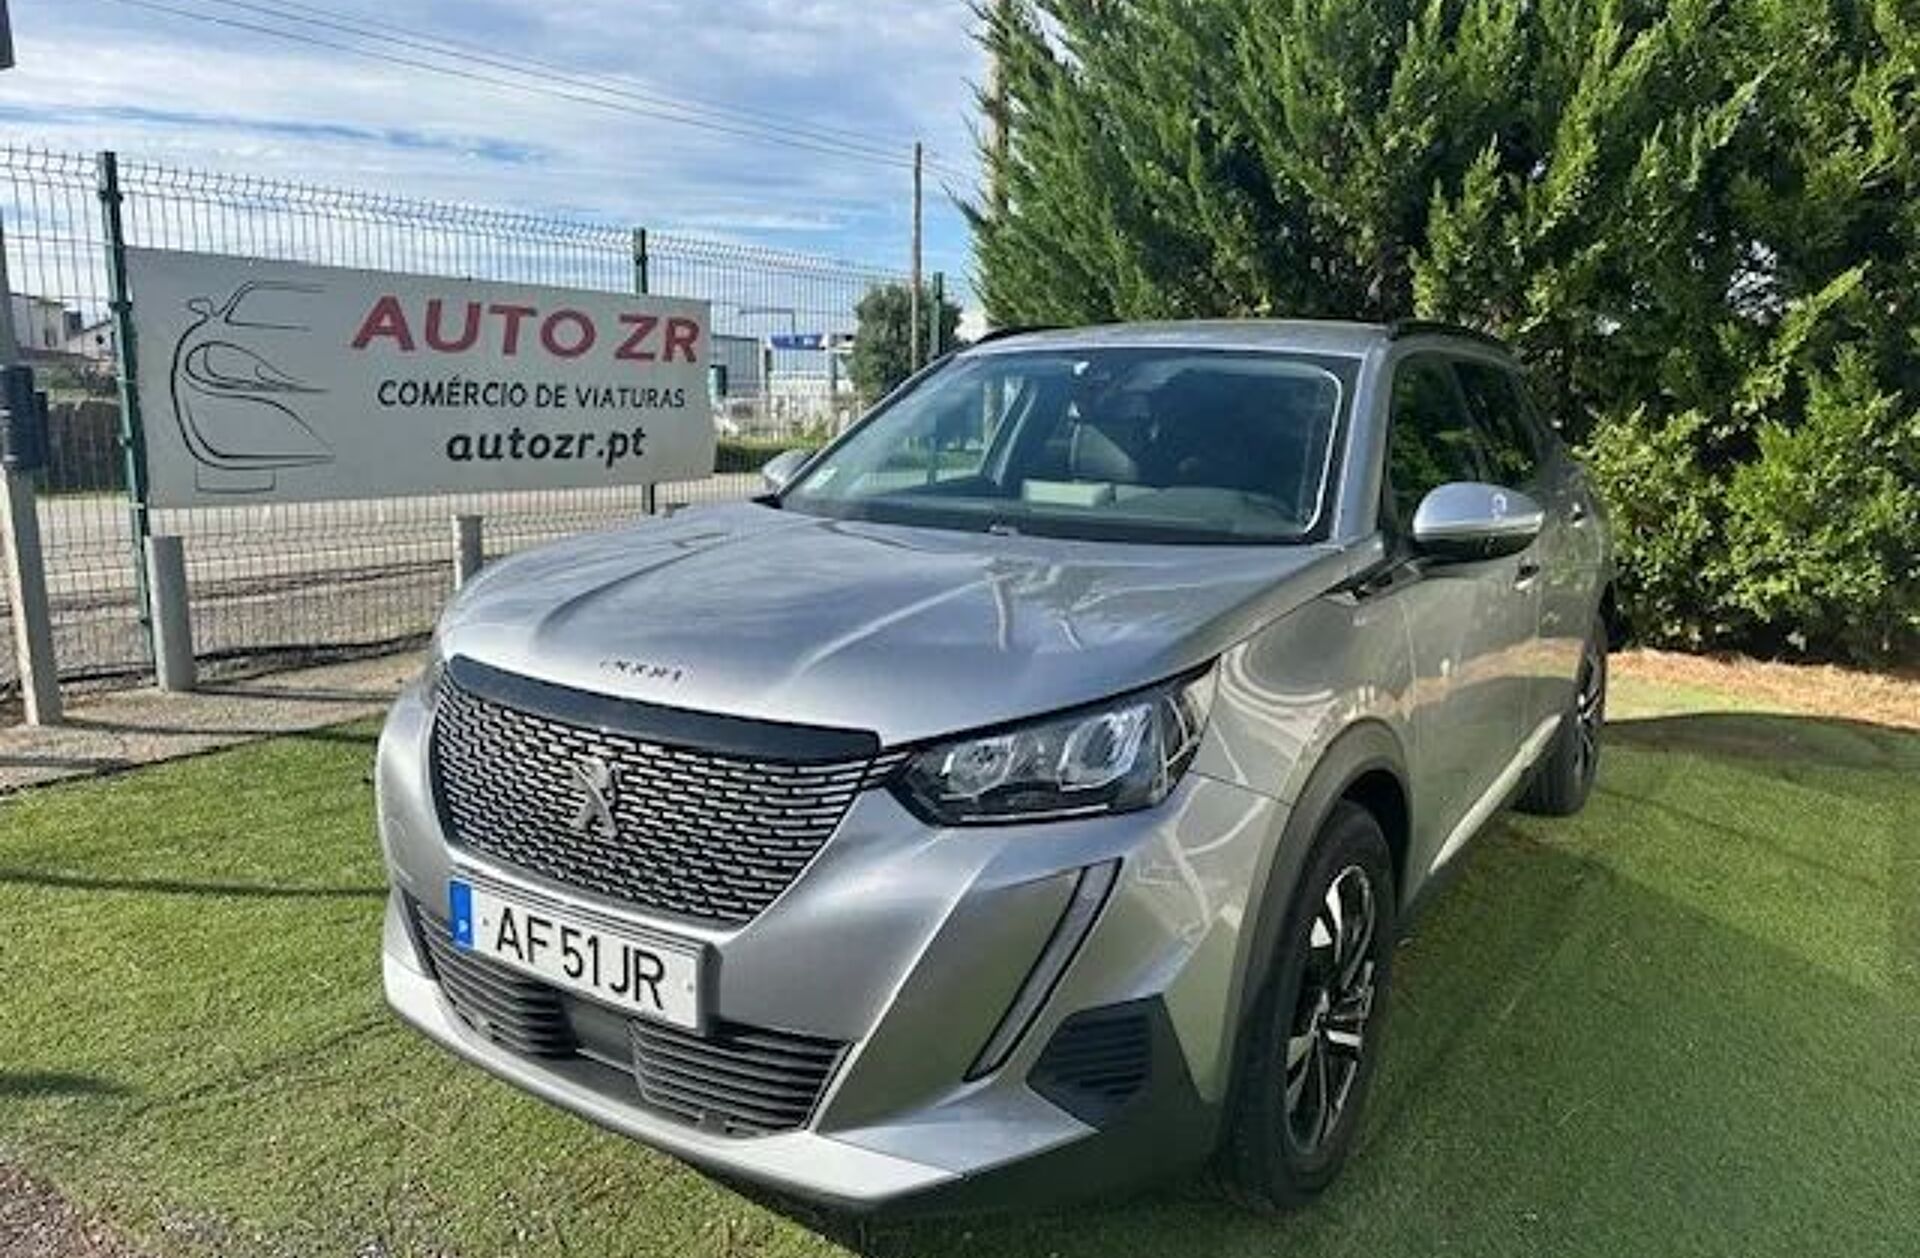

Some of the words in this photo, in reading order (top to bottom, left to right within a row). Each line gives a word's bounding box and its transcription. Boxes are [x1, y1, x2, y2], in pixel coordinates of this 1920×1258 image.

[351, 295, 597, 359] AUTO
[614, 313, 702, 363] ZR
[376, 375, 529, 408] COMÉRCIO
[536, 385, 567, 409] DE
[575, 386, 686, 409] VIATURAS
[446, 427, 647, 468] autozr.pt
[496, 907, 552, 964] AF
[560, 926, 600, 987] 51
[610, 945, 665, 1011] JR
